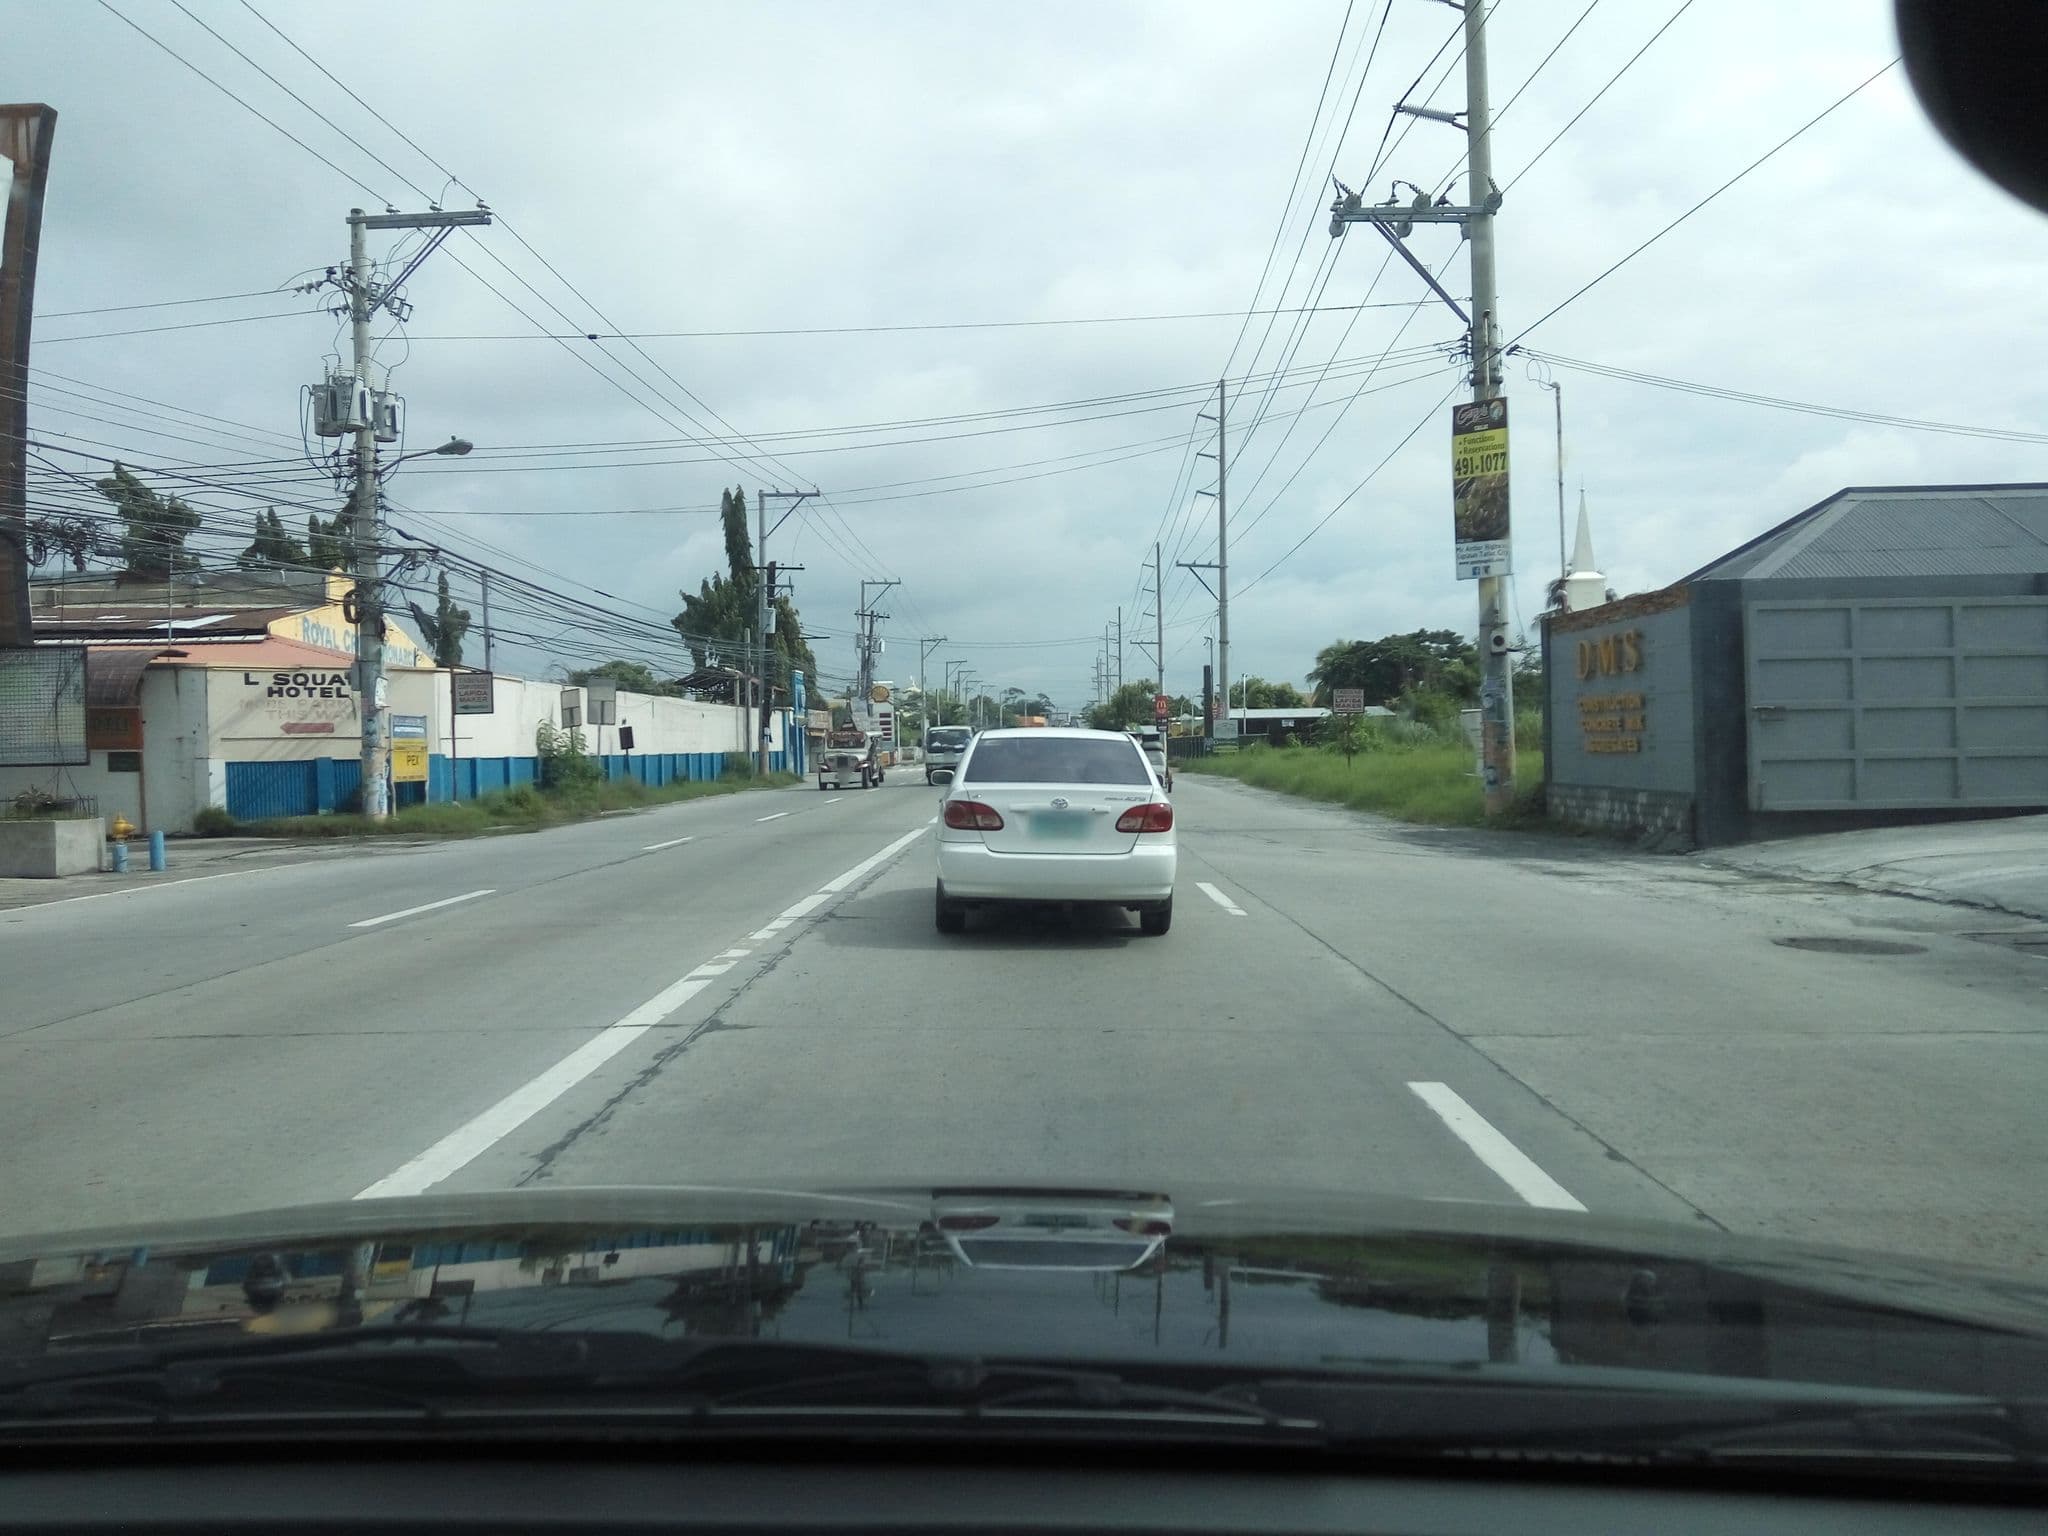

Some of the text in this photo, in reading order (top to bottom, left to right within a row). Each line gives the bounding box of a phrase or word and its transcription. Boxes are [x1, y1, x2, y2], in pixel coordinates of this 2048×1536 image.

[1455, 452, 1507, 476] 491-1077
[302, 616, 340, 650] ROYAL
[244, 673, 259, 686] L
[267, 686, 350, 698] HOTEL
